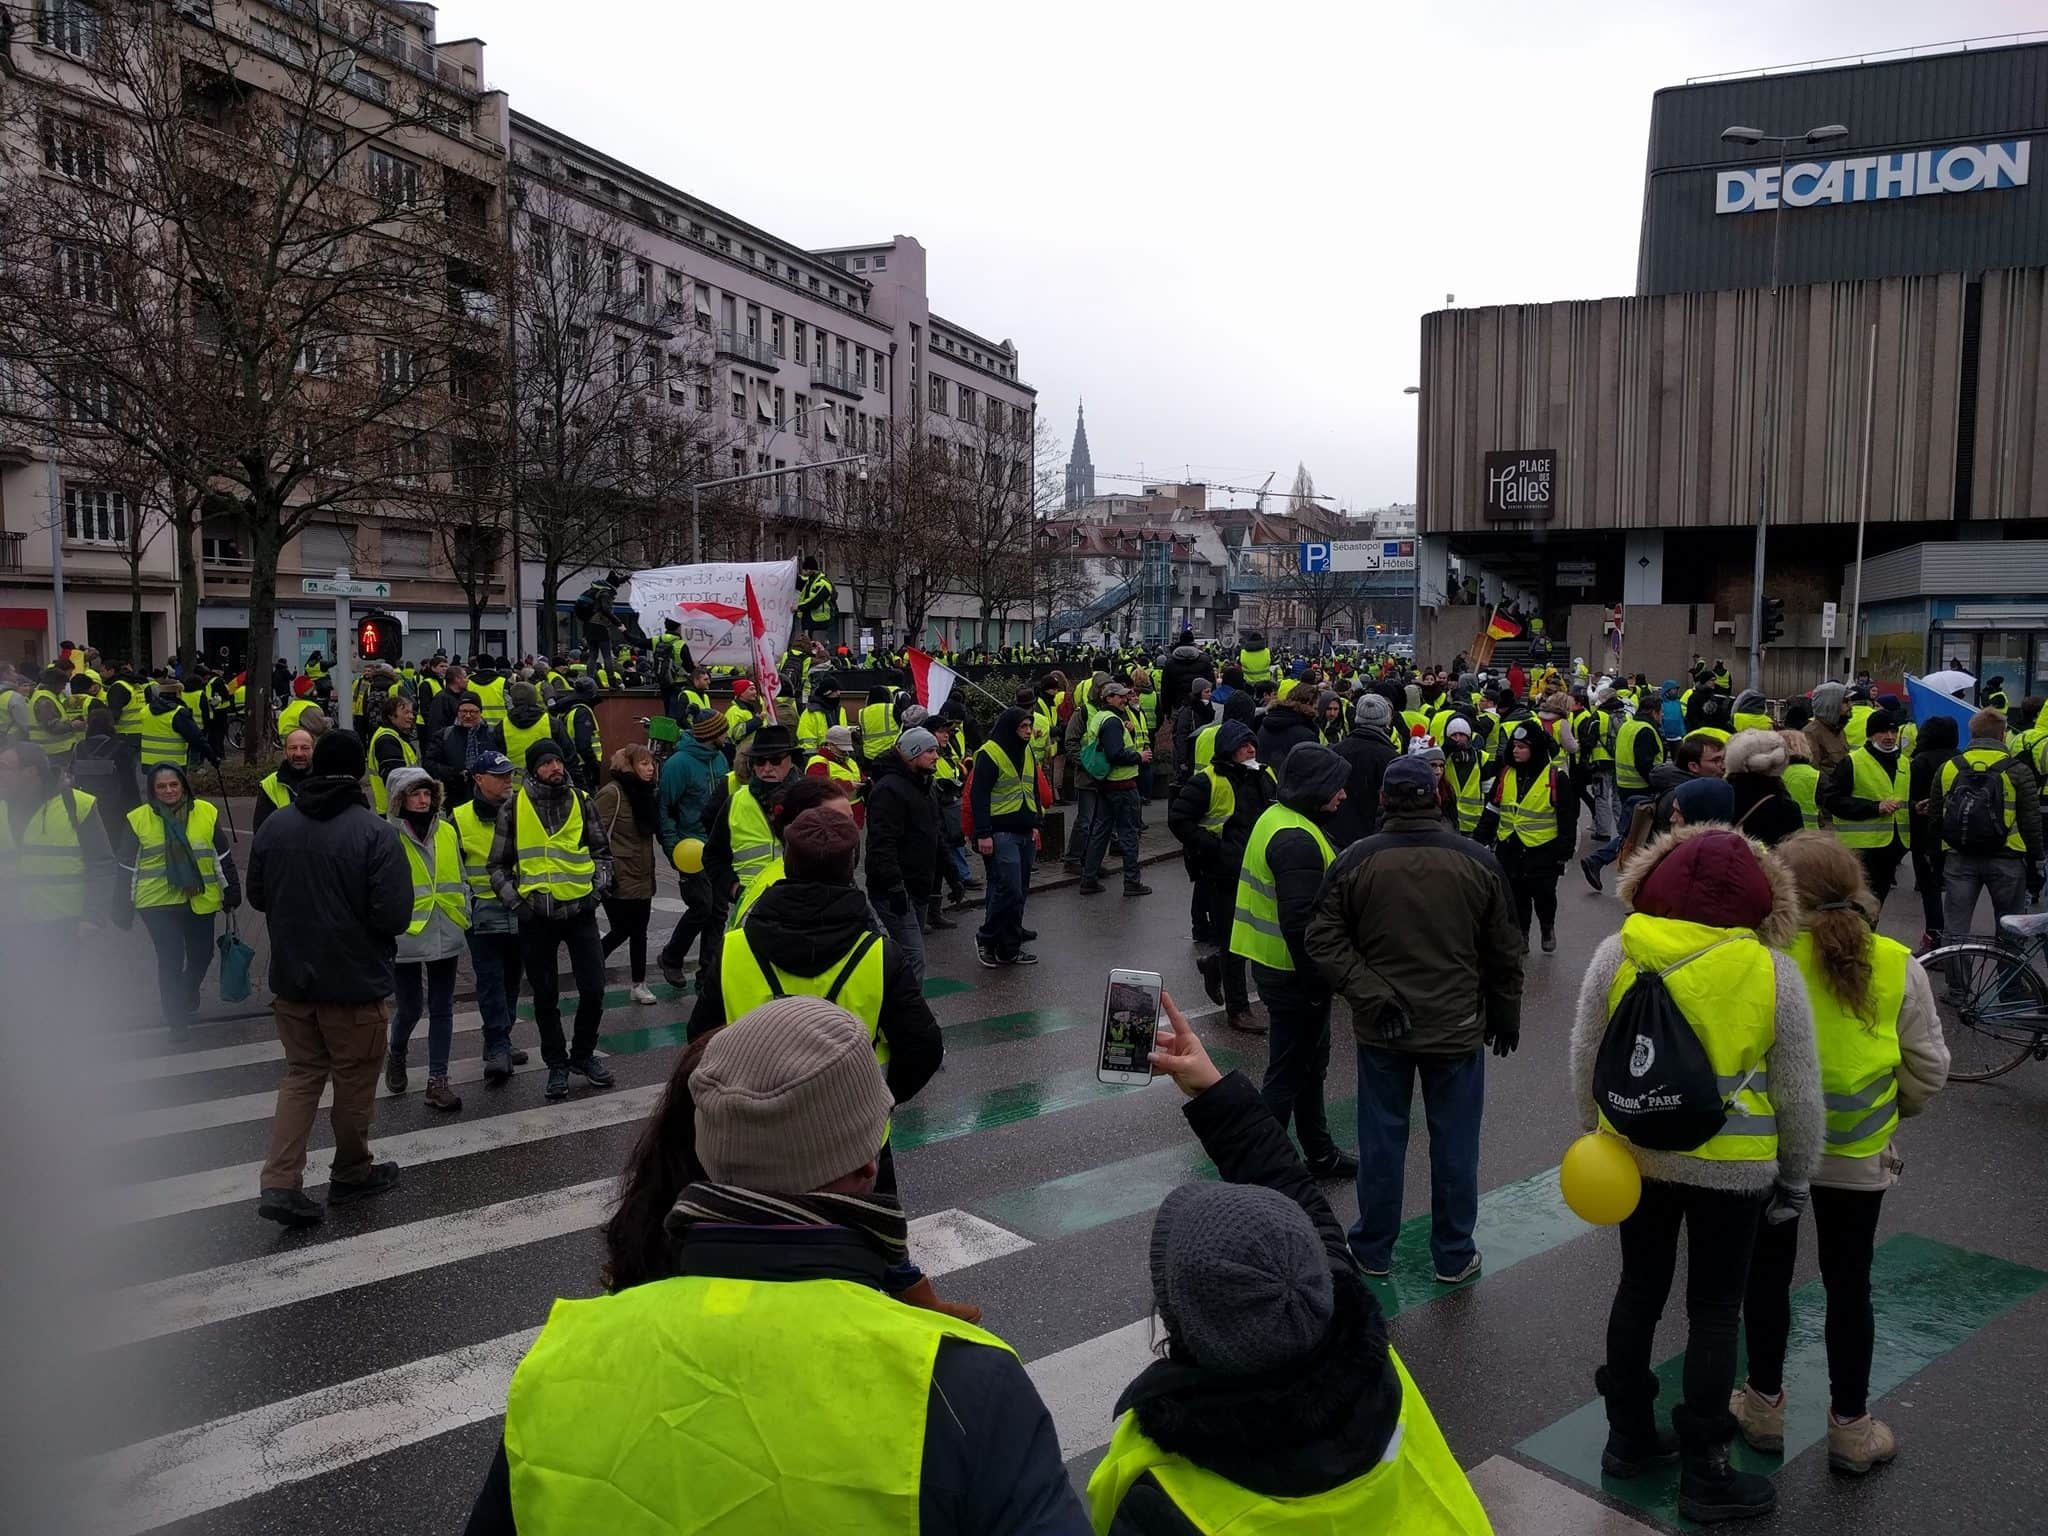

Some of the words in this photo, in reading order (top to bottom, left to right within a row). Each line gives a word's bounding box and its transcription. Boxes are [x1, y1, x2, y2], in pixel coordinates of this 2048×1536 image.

[1715, 141, 2031, 214] DECATHLON
[1519, 459, 1551, 473] PLACE
[1489, 465, 1550, 510] Halles
[1382, 558, 1414, 568] Hôtels
[1648, 1094, 1683, 1107] PARK
